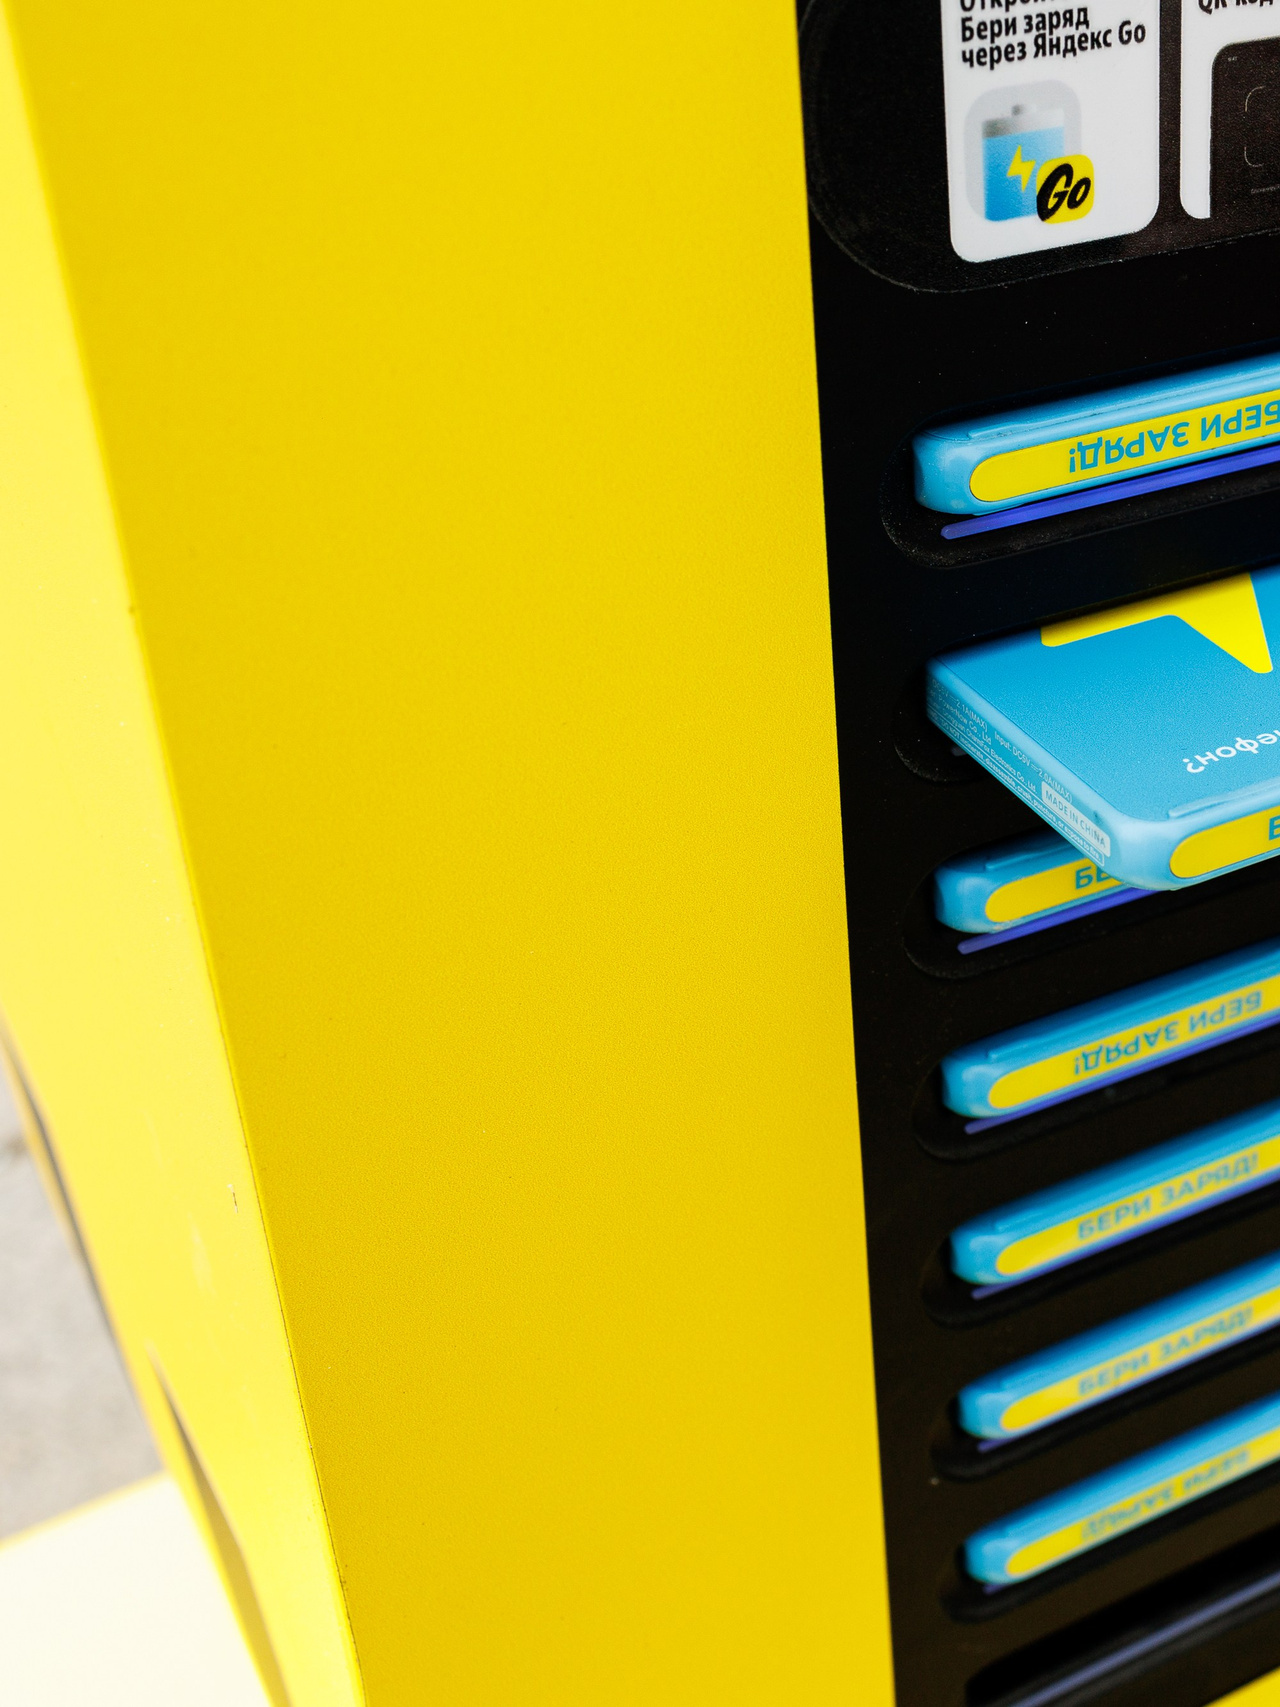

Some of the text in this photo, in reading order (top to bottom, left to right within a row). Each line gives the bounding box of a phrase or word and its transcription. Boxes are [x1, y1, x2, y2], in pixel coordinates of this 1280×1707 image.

[961, 7, 1089, 43] Бери заряд
[962, 20, 1147, 70] через Яндекс Go
[1036, 163, 1091, 222] Go
[1069, 421, 1190, 473] ЗАРЯД!
[1043, 787, 1107, 849] MADE IN CHINA
[1074, 990, 1262, 1075] БЕРИ ЗАРЯД!
[1078, 1151, 1259, 1240] БЕРИ ЗАРЯД!
